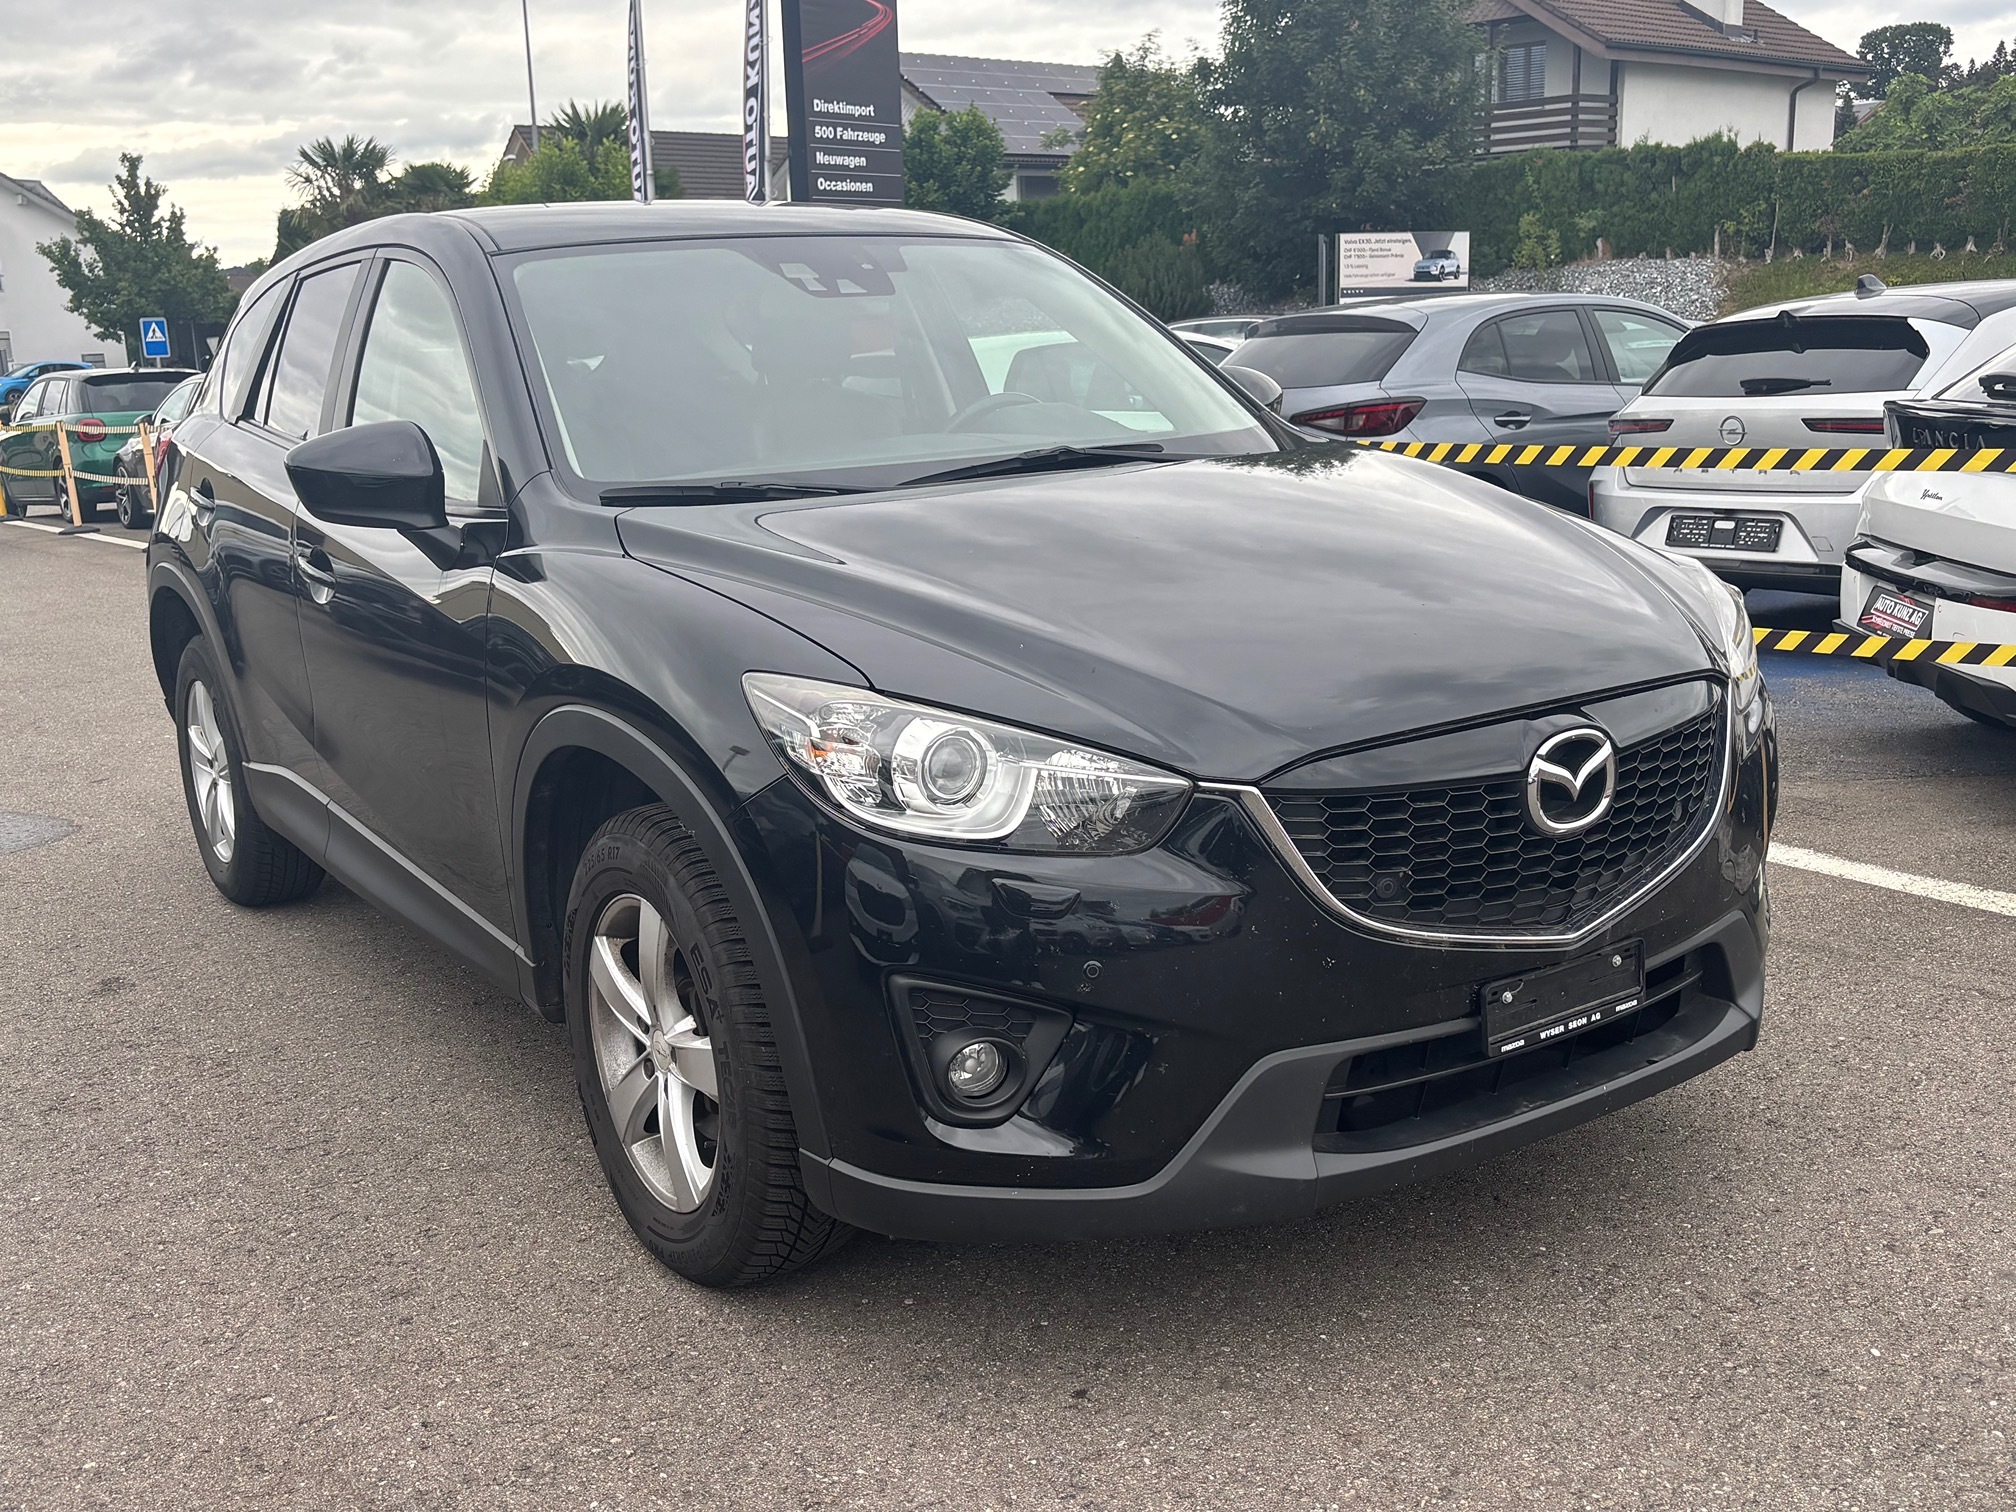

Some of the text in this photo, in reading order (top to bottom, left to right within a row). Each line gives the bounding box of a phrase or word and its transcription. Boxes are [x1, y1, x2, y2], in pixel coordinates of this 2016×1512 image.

[745, 0, 760, 201] AUTO KUN
[813, 98, 875, 117] Direktimport
[814, 125, 886, 145] 500 Fahrzeuge
[816, 151, 867, 169] Neuwagen
[817, 177, 873, 192] Occasionen
[1912, 427, 1985, 450] LANCIA
[1920, 488, 1943, 500] Ypsilon
[1874, 597, 1923, 625] AUTO KUNZ AG
[607, 846, 621, 861] R17
[1501, 999, 1638, 1052] mazda WYSER SEON AG mazda
